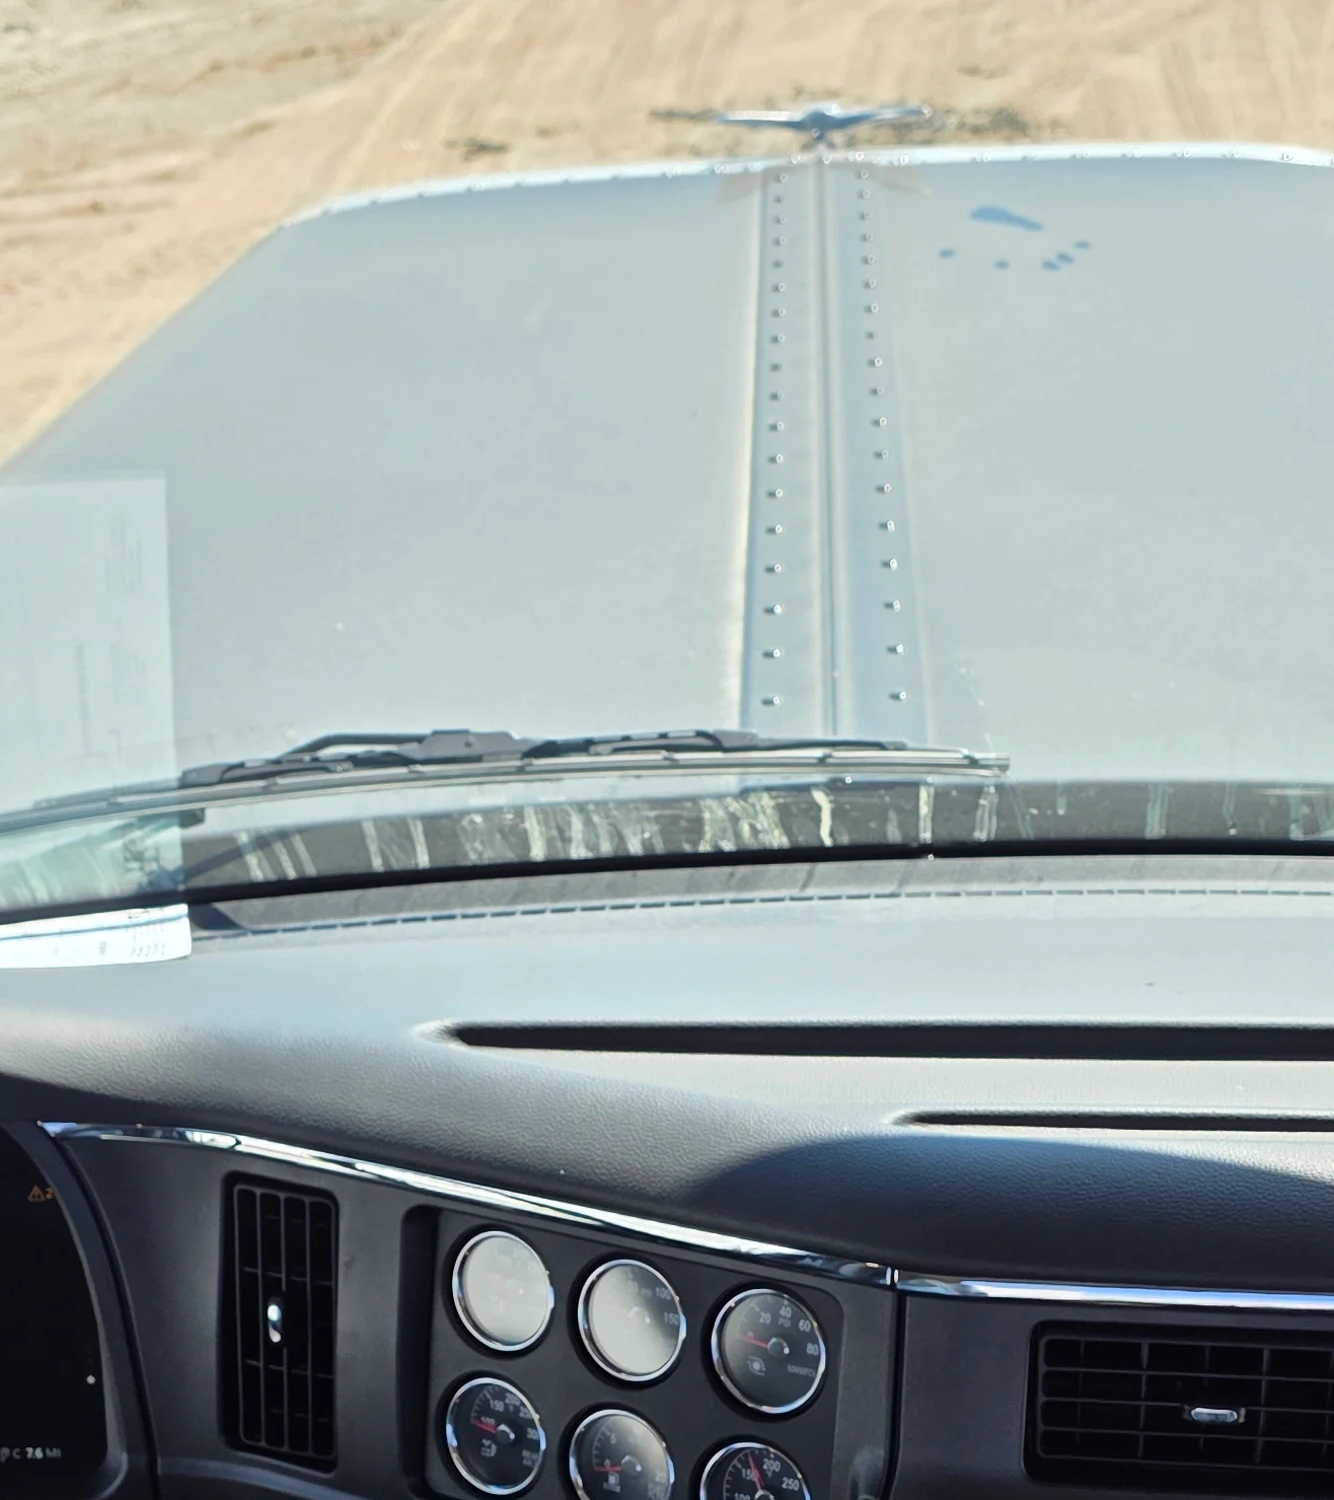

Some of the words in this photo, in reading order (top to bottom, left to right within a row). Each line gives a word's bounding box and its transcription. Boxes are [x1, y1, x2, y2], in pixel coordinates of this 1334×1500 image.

[759, 1311, 772, 1324] 20
[779, 1306, 792, 1319] 40
[798, 1319, 811, 1332] 60
[763, 1458, 781, 1473] 200
[781, 1476, 800, 1491] 250
